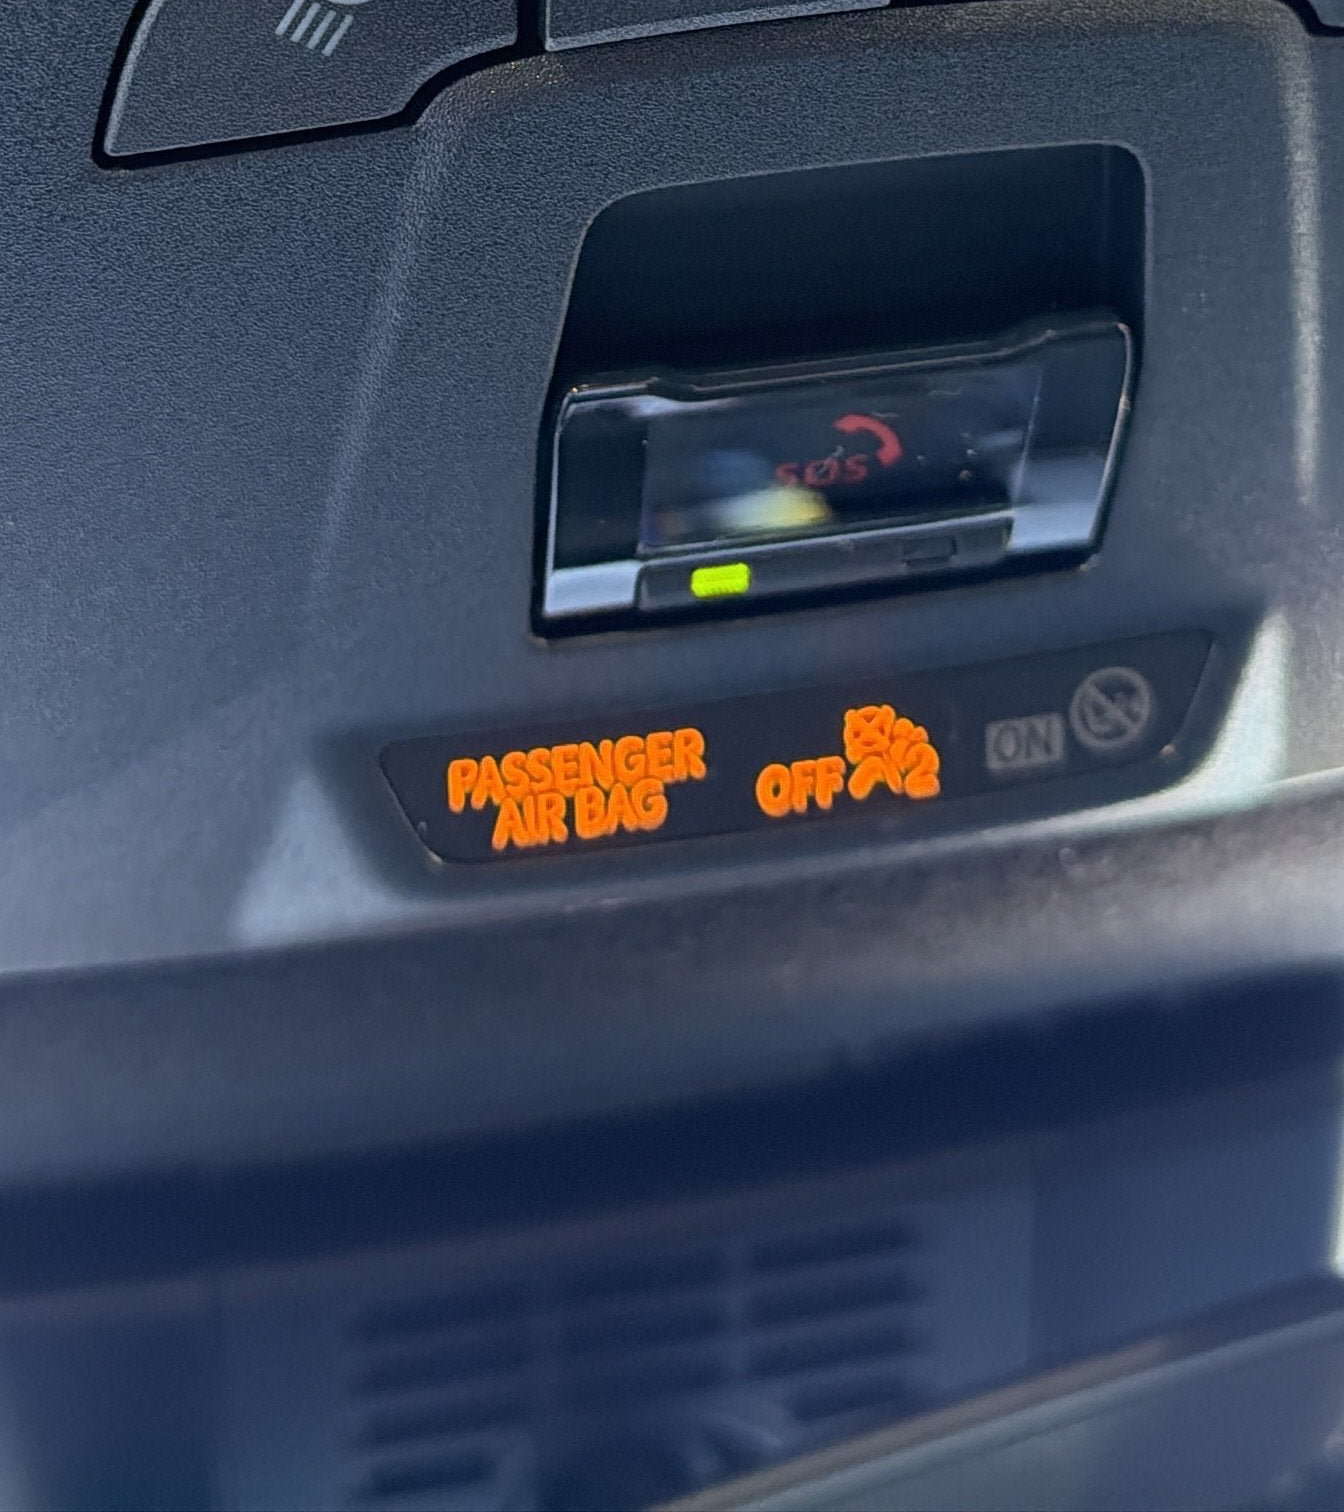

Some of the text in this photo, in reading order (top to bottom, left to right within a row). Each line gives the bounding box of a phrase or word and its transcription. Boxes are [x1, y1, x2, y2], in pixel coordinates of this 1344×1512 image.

[774, 453, 871, 487] SOS
[447, 727, 707, 814] PASSENGER
[990, 721, 1055, 764] ON
[491, 778, 669, 851] AIR BAG
[756, 756, 846, 818] OFF
